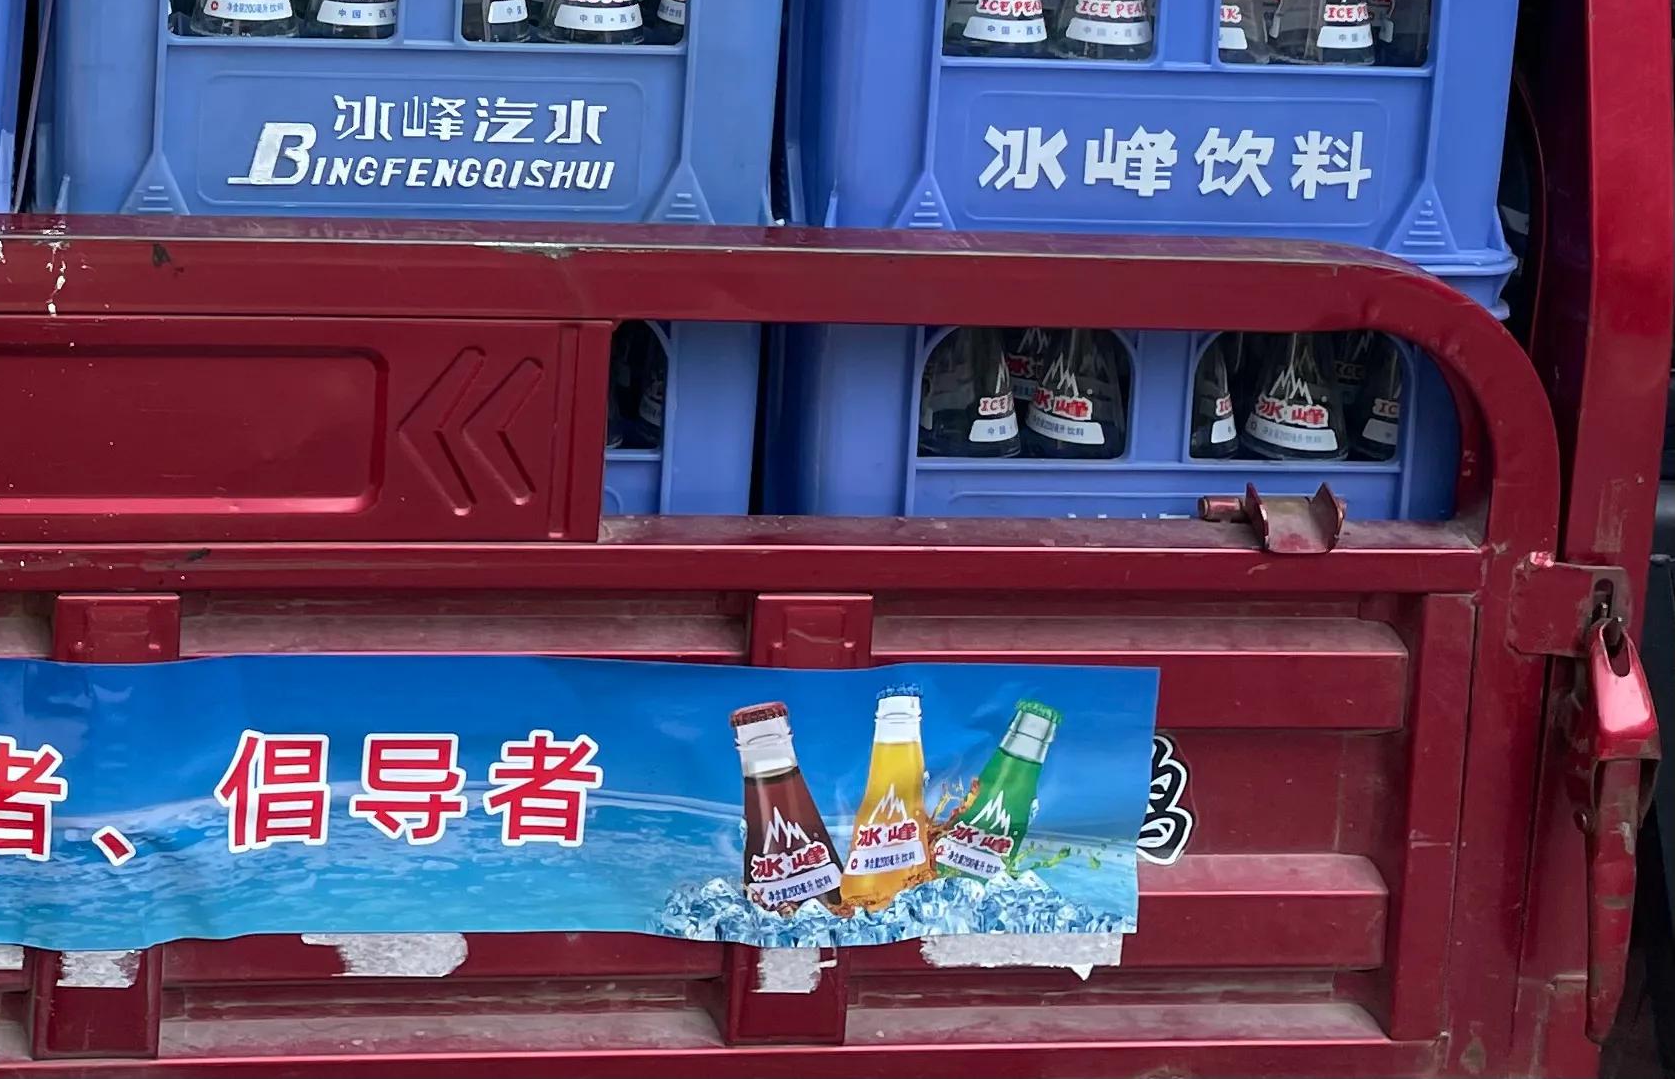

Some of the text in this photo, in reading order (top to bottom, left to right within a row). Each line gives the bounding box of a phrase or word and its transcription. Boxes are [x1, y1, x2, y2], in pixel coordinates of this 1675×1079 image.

[1080, 0, 1110, 14] ICE
[1327, 8, 1354, 19] ICE
[333, 95, 608, 145] 冰峰汽水
[227, 122, 615, 190] BINGFENGQISHUI
[978, 125, 1372, 199] 冰峰饮料
[980, 397, 1007, 412] ICE
[1258, 400, 1325, 425] 冰峰
[856, 821, 918, 848] 冰峰
[950, 824, 1012, 855] 冰峰
[752, 844, 827, 879] 冰峰
